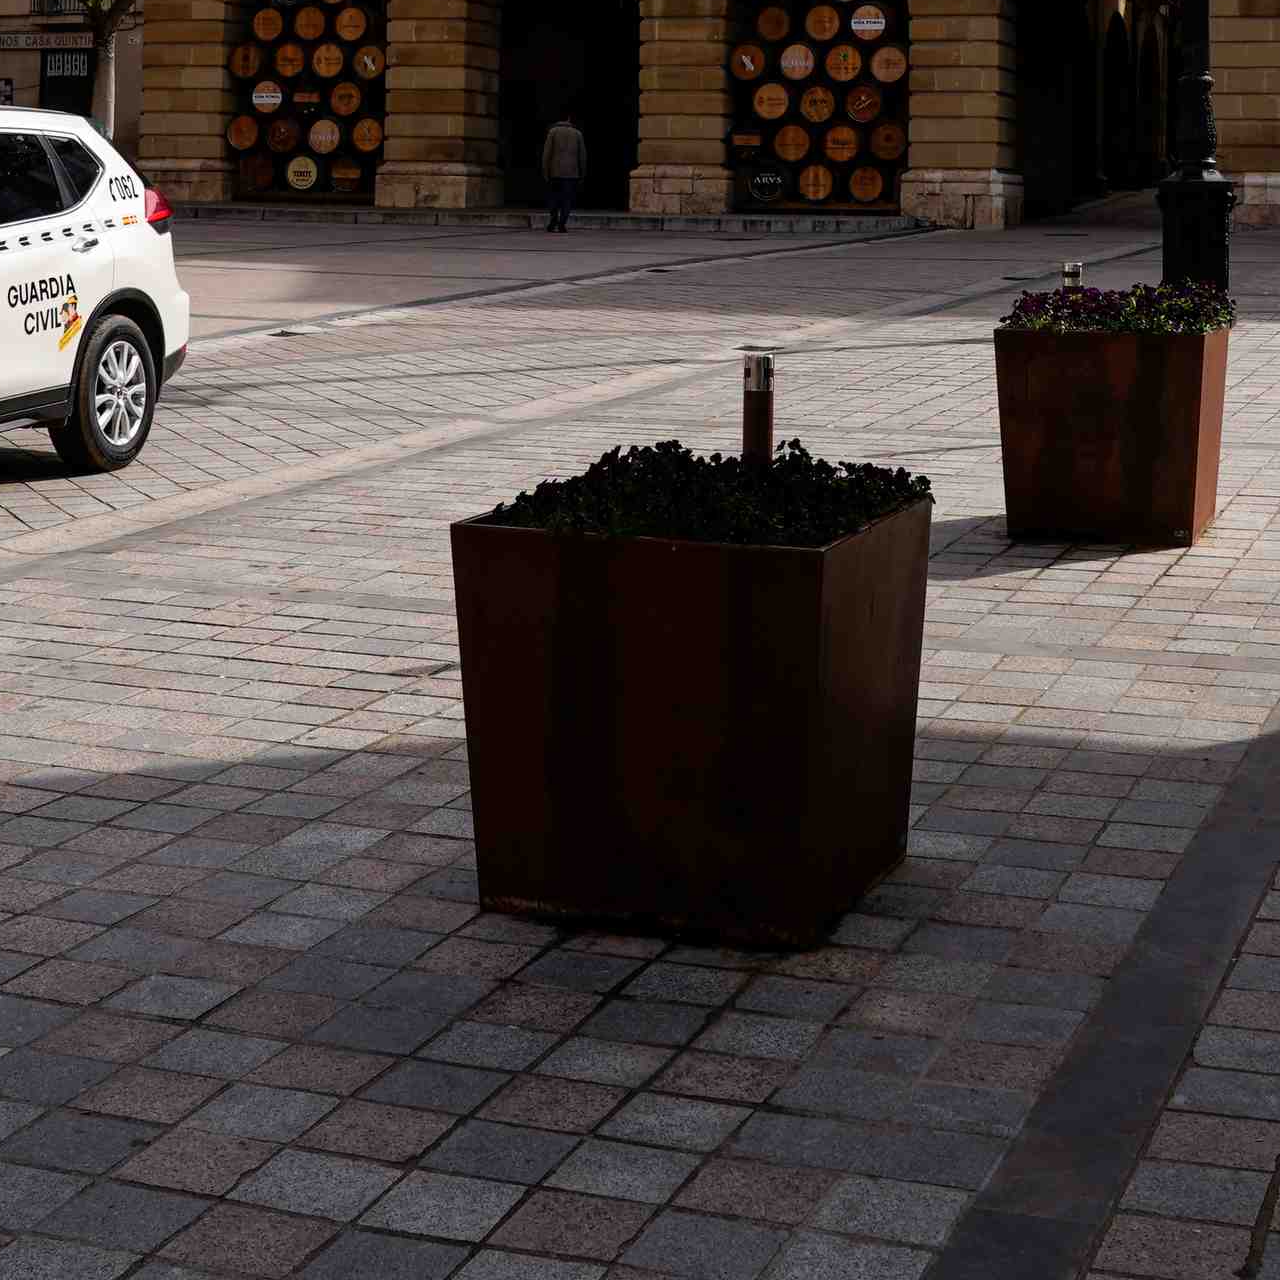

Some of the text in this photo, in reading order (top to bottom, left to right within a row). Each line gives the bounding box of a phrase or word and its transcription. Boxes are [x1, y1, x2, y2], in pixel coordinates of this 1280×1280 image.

[116, 175, 139, 201] 062
[7, 273, 77, 308] GUARDIA
[24, 306, 62, 335] CIVIL
